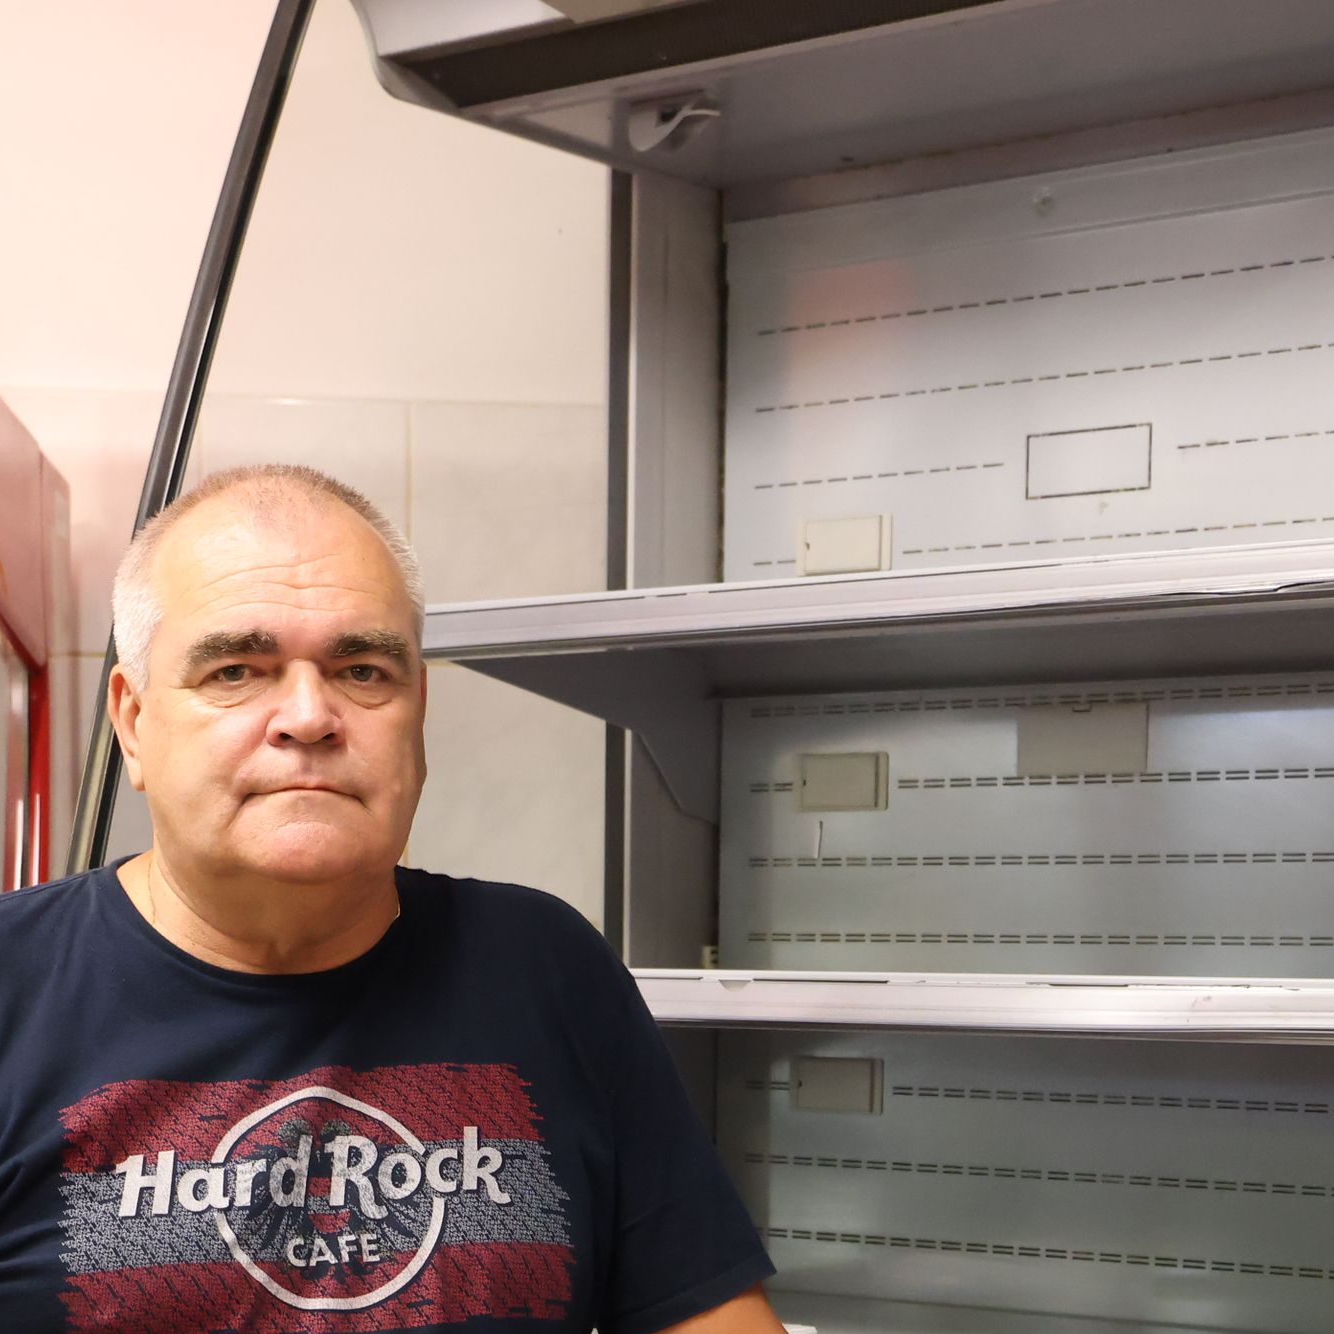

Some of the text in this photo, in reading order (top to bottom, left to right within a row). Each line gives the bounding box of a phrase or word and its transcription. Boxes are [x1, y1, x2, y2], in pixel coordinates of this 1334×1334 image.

[115, 1126, 512, 1220] Hard Rock
[285, 1232, 381, 1269] CAFE
